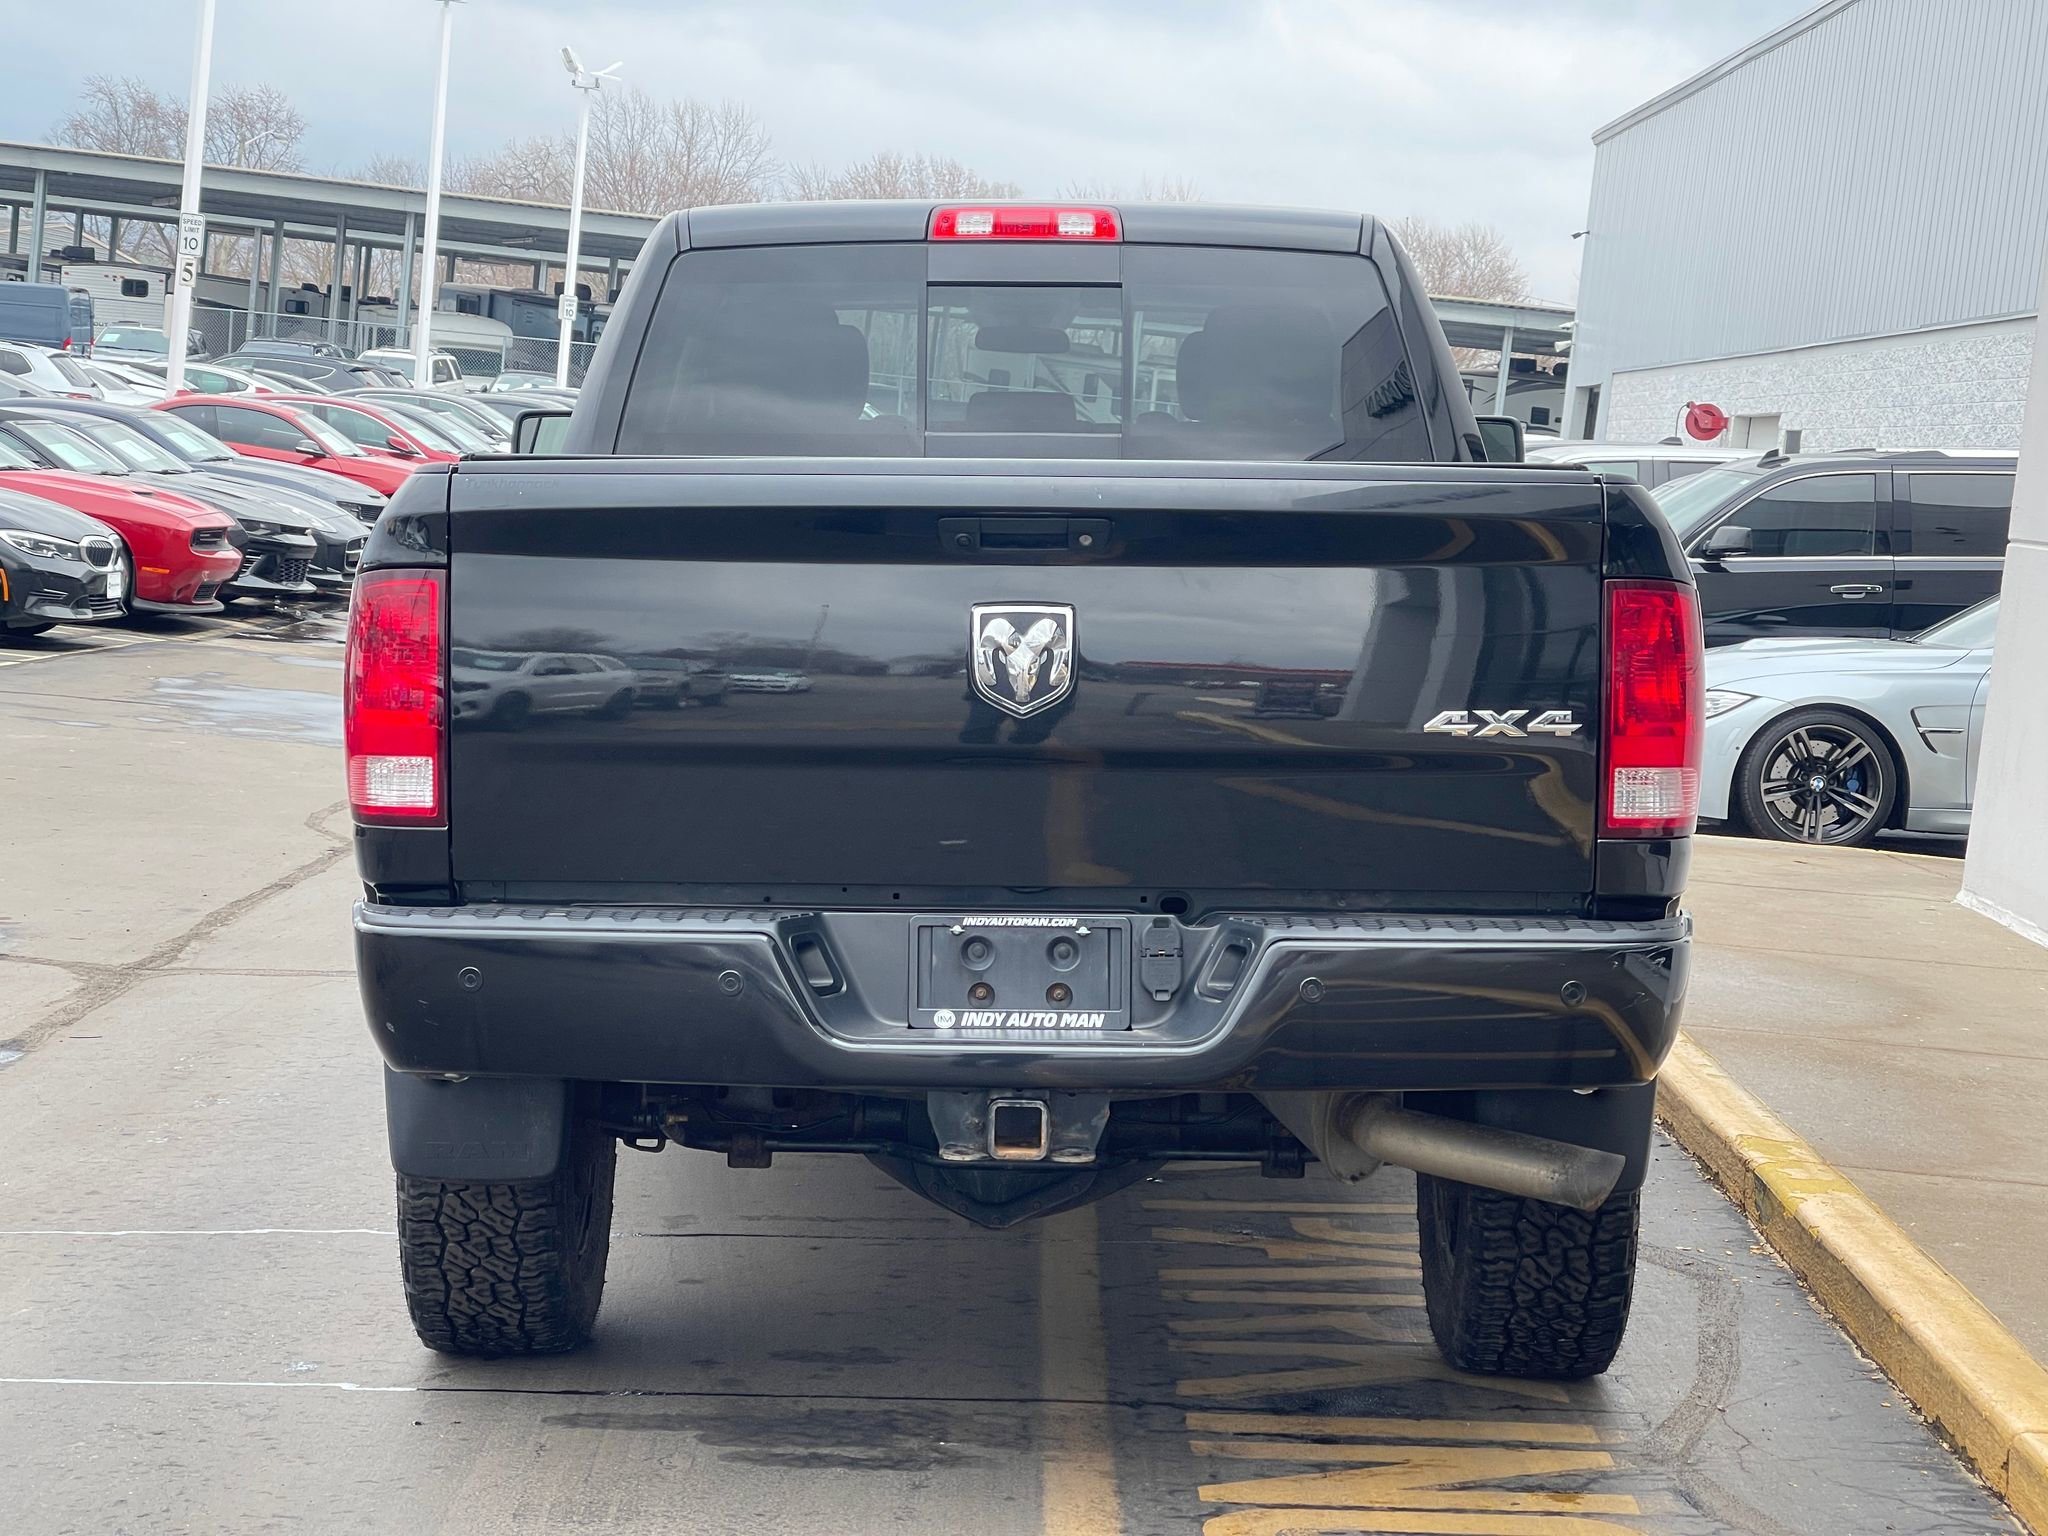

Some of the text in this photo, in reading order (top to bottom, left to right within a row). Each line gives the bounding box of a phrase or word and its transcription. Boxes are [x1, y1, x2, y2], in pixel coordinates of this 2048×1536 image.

[183, 218, 202, 226] SPEED
[184, 237, 198, 250] 10
[182, 262, 194, 282] 5
[565, 308, 574, 317] 10
[962, 916, 1078, 927] INDYAUTOMAN.COM
[960, 1012, 1105, 1028] INDY AUTO MAN
